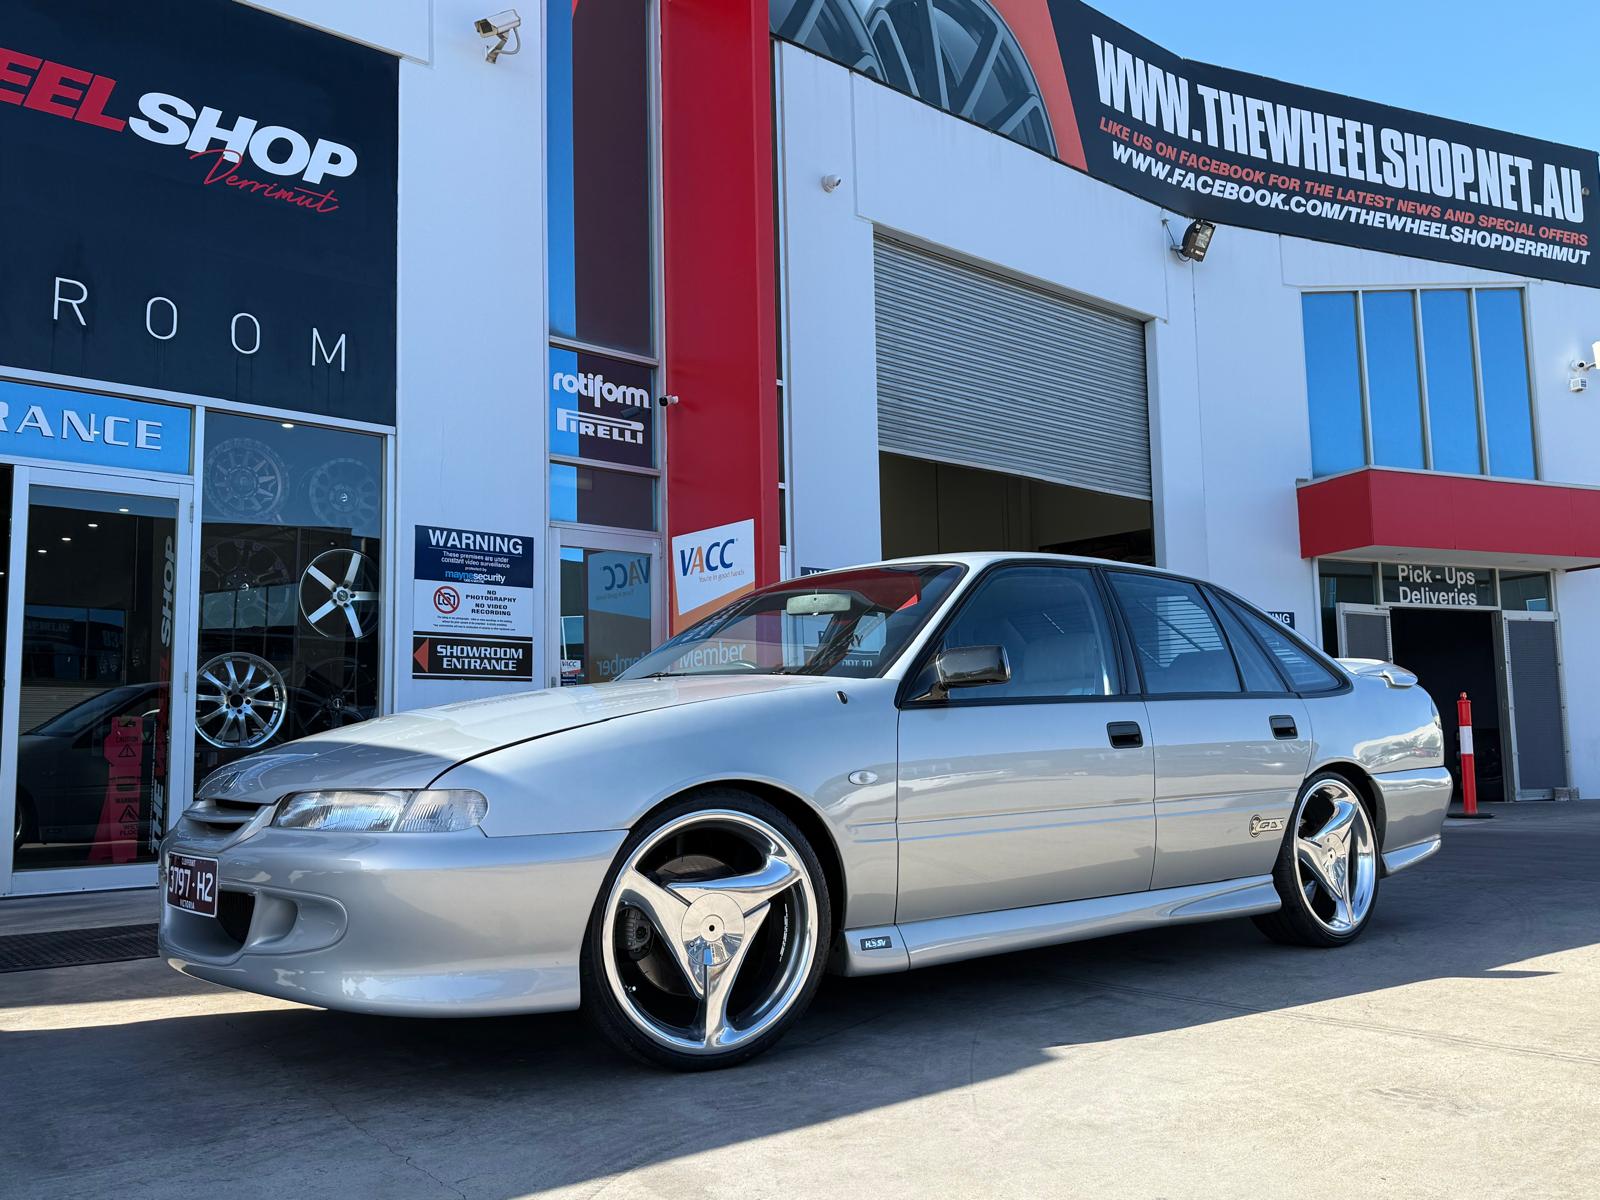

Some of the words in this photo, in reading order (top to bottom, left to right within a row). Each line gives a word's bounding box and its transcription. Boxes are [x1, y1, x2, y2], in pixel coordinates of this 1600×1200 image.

[1091, 33, 1584, 224] WWW.THEWHEELSHOP.NET.AU
[190, 149, 339, 213] Derrimut
[1099, 116, 1131, 141] LIKE
[1133, 133, 1153, 150] US
[1155, 141, 1178, 160] ON
[1179, 150, 1265, 184] FACEBOOK
[1268, 173, 1301, 192] FOR
[1304, 179, 1334, 198] THE
[1336, 186, 1394, 208] LATEST
[1396, 199, 1441, 219] NEWS
[1443, 208, 1476, 225] AND
[1478, 213, 1535, 237] SPECIAL
[1538, 226, 1588, 247] OFFERS
[1111, 140, 1591, 266] WWW.FACEBOOK.COM/THEWHEELSHOPDERRIMUT
[553, 372, 650, 408] rotiform
[0, 401, 163, 450] ANCE
[557, 407, 645, 444] PIRELLI
[428, 529, 523, 554] WARNING
[443, 550, 459, 558] These
[460, 553, 484, 561] premises
[441, 557, 464, 565] constant
[480, 560, 511, 569] surveillance
[680, 538, 735, 577] VACC
[1397, 564, 1433, 584] Pick
[1445, 566, 1476, 589] Ups
[161, 535, 175, 648] SHOP
[465, 594, 517, 603] PHOTOGRAPHY
[1399, 586, 1478, 606] Deliveries
[471, 608, 512, 616] RECORDING
[436, 644, 523, 660] SHOWROOM
[443, 657, 517, 671] ENTRANCE
[679, 640, 747, 668] Member
